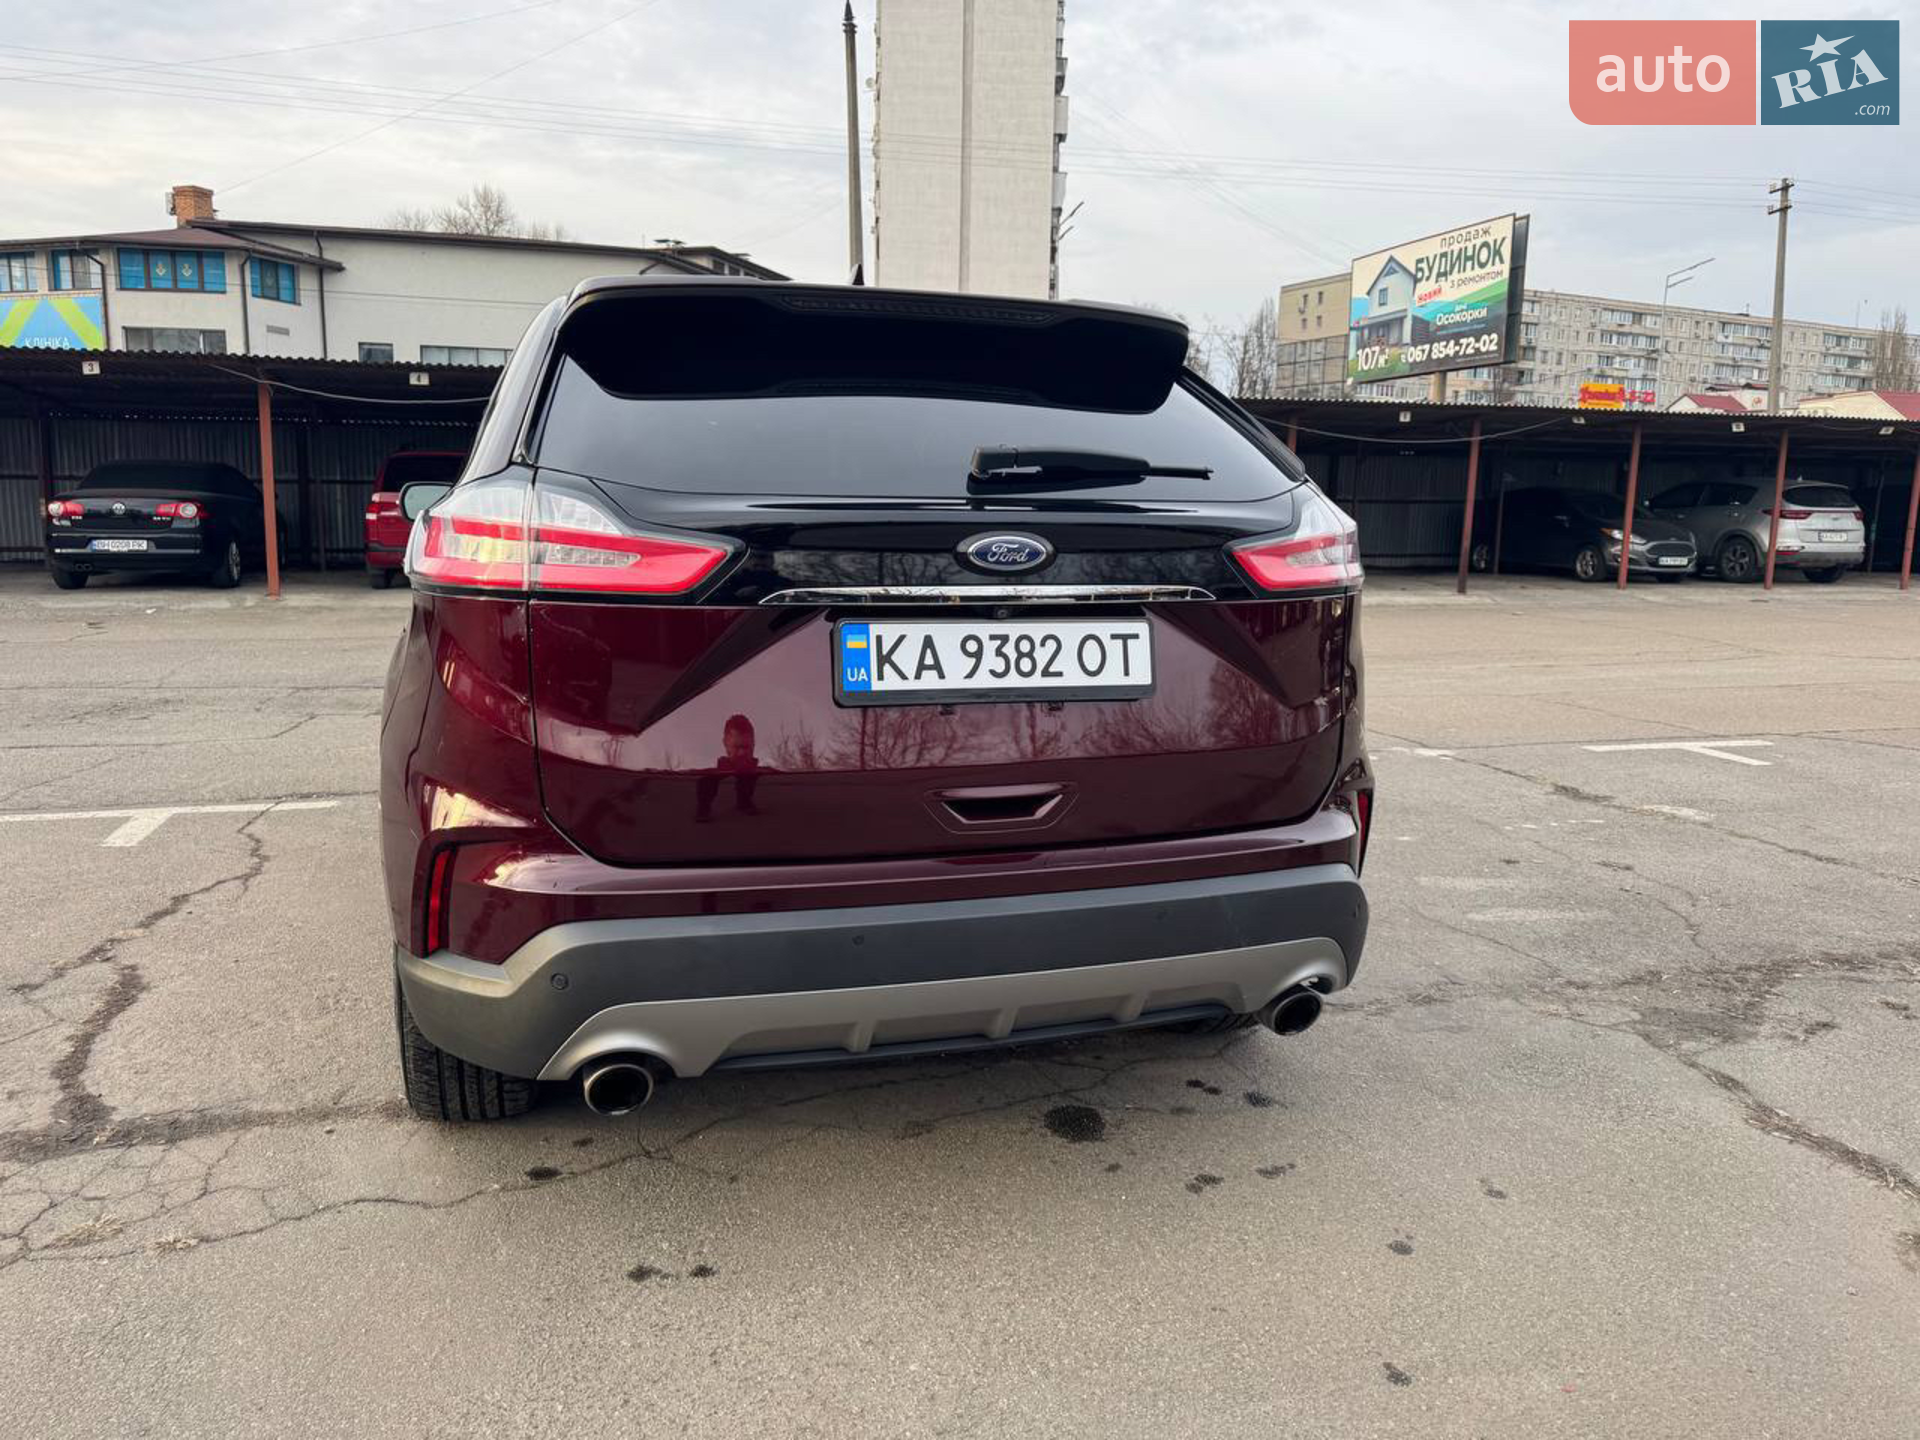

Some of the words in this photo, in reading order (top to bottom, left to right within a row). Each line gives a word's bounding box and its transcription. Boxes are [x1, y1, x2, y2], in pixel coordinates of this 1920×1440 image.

[1440, 226, 1491, 248] продаж
[1415, 236, 1506, 283] БУДИНОК
[1457, 270, 1503, 287] ремонтом
[1436, 306, 1488, 326] Осокорки
[1407, 345, 1430, 363] 067
[1431, 333, 1498, 359] 854-72-02
[88, 363, 94, 372] 3
[987, 542, 1029, 563] Ford
[847, 668, 869, 682] UA
[876, 633, 946, 681] KA
[960, 633, 1064, 680] 9382
[1077, 633, 1140, 678] OT
